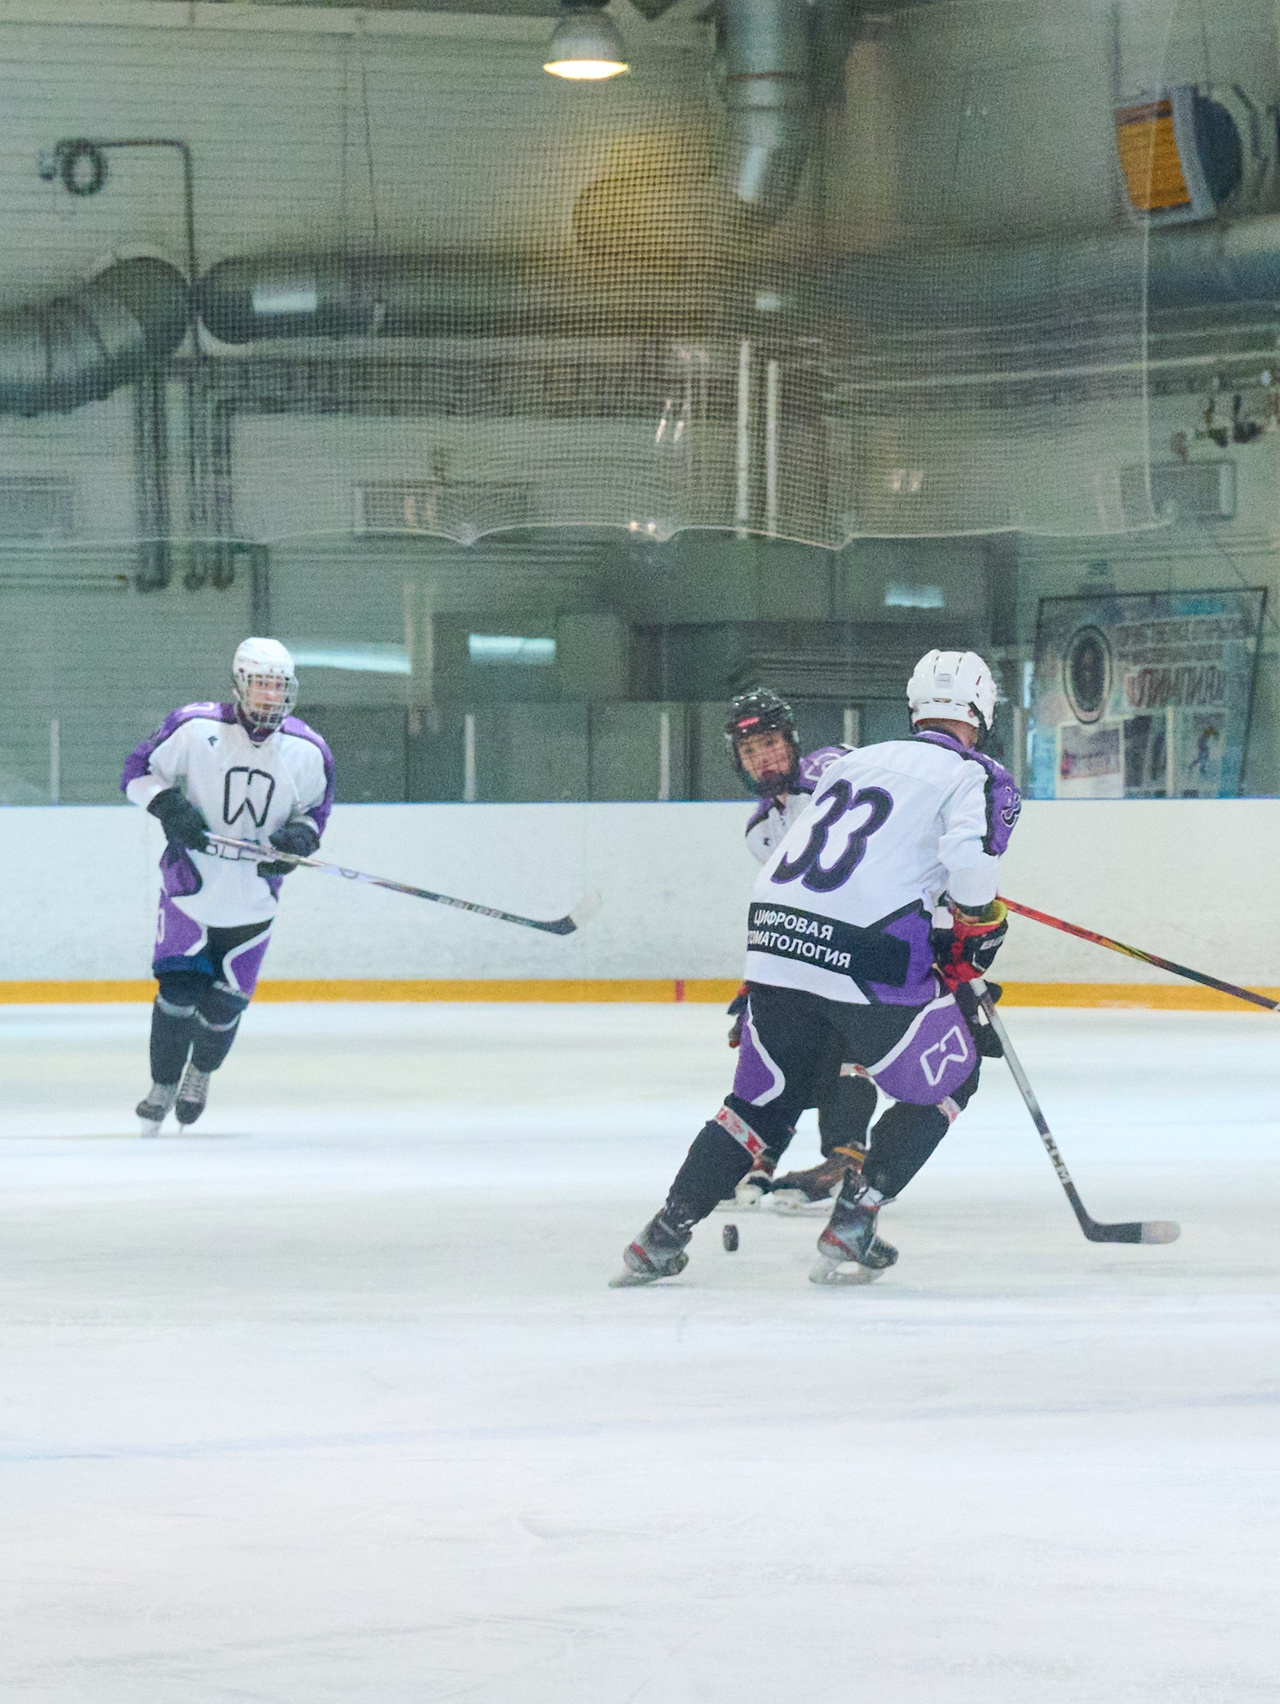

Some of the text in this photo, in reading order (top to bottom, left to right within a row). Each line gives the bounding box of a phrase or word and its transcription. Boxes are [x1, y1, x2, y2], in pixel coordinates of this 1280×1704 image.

[770, 778, 894, 893] 33
[754, 909, 834, 941] ЦИФРОВАЯ
[748, 930, 852, 969] МАТОЛОГИЯ
